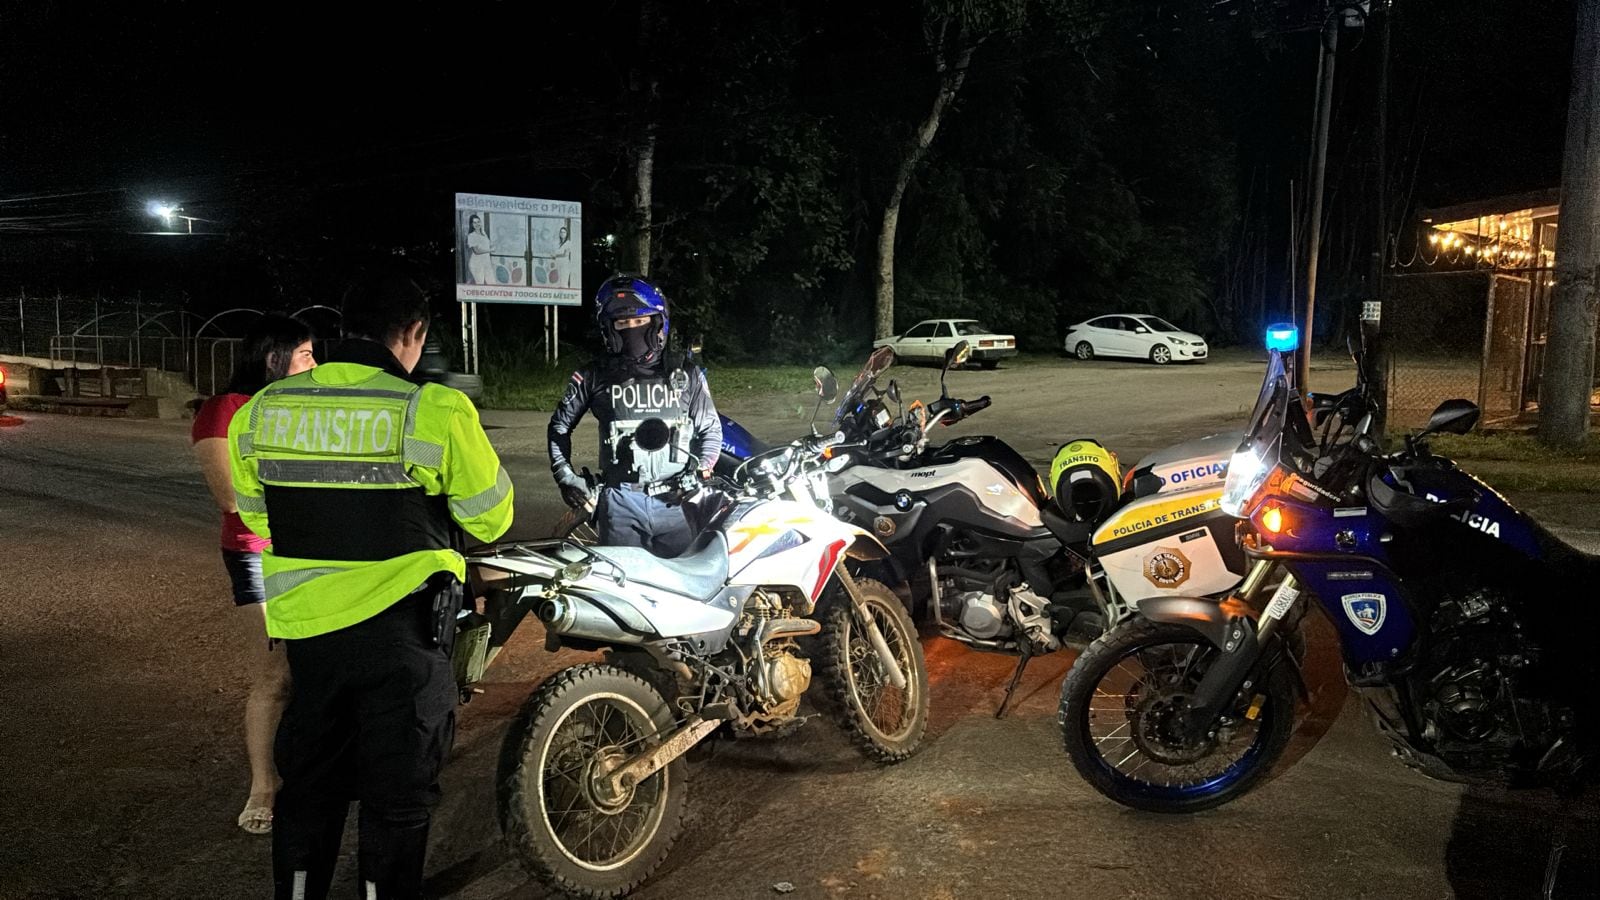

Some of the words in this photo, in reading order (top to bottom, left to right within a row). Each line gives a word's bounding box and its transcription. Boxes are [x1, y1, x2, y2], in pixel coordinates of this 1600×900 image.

[541, 204, 549, 212] a
[551, 204, 580, 215] PITAL
[612, 384, 681, 409] POLICIA
[261, 406, 393, 453] TRANSITO
[1060, 455, 1099, 469] TRANSITO
[1113, 520, 1153, 537] POLICIA
[1154, 514, 1169, 525] DE
